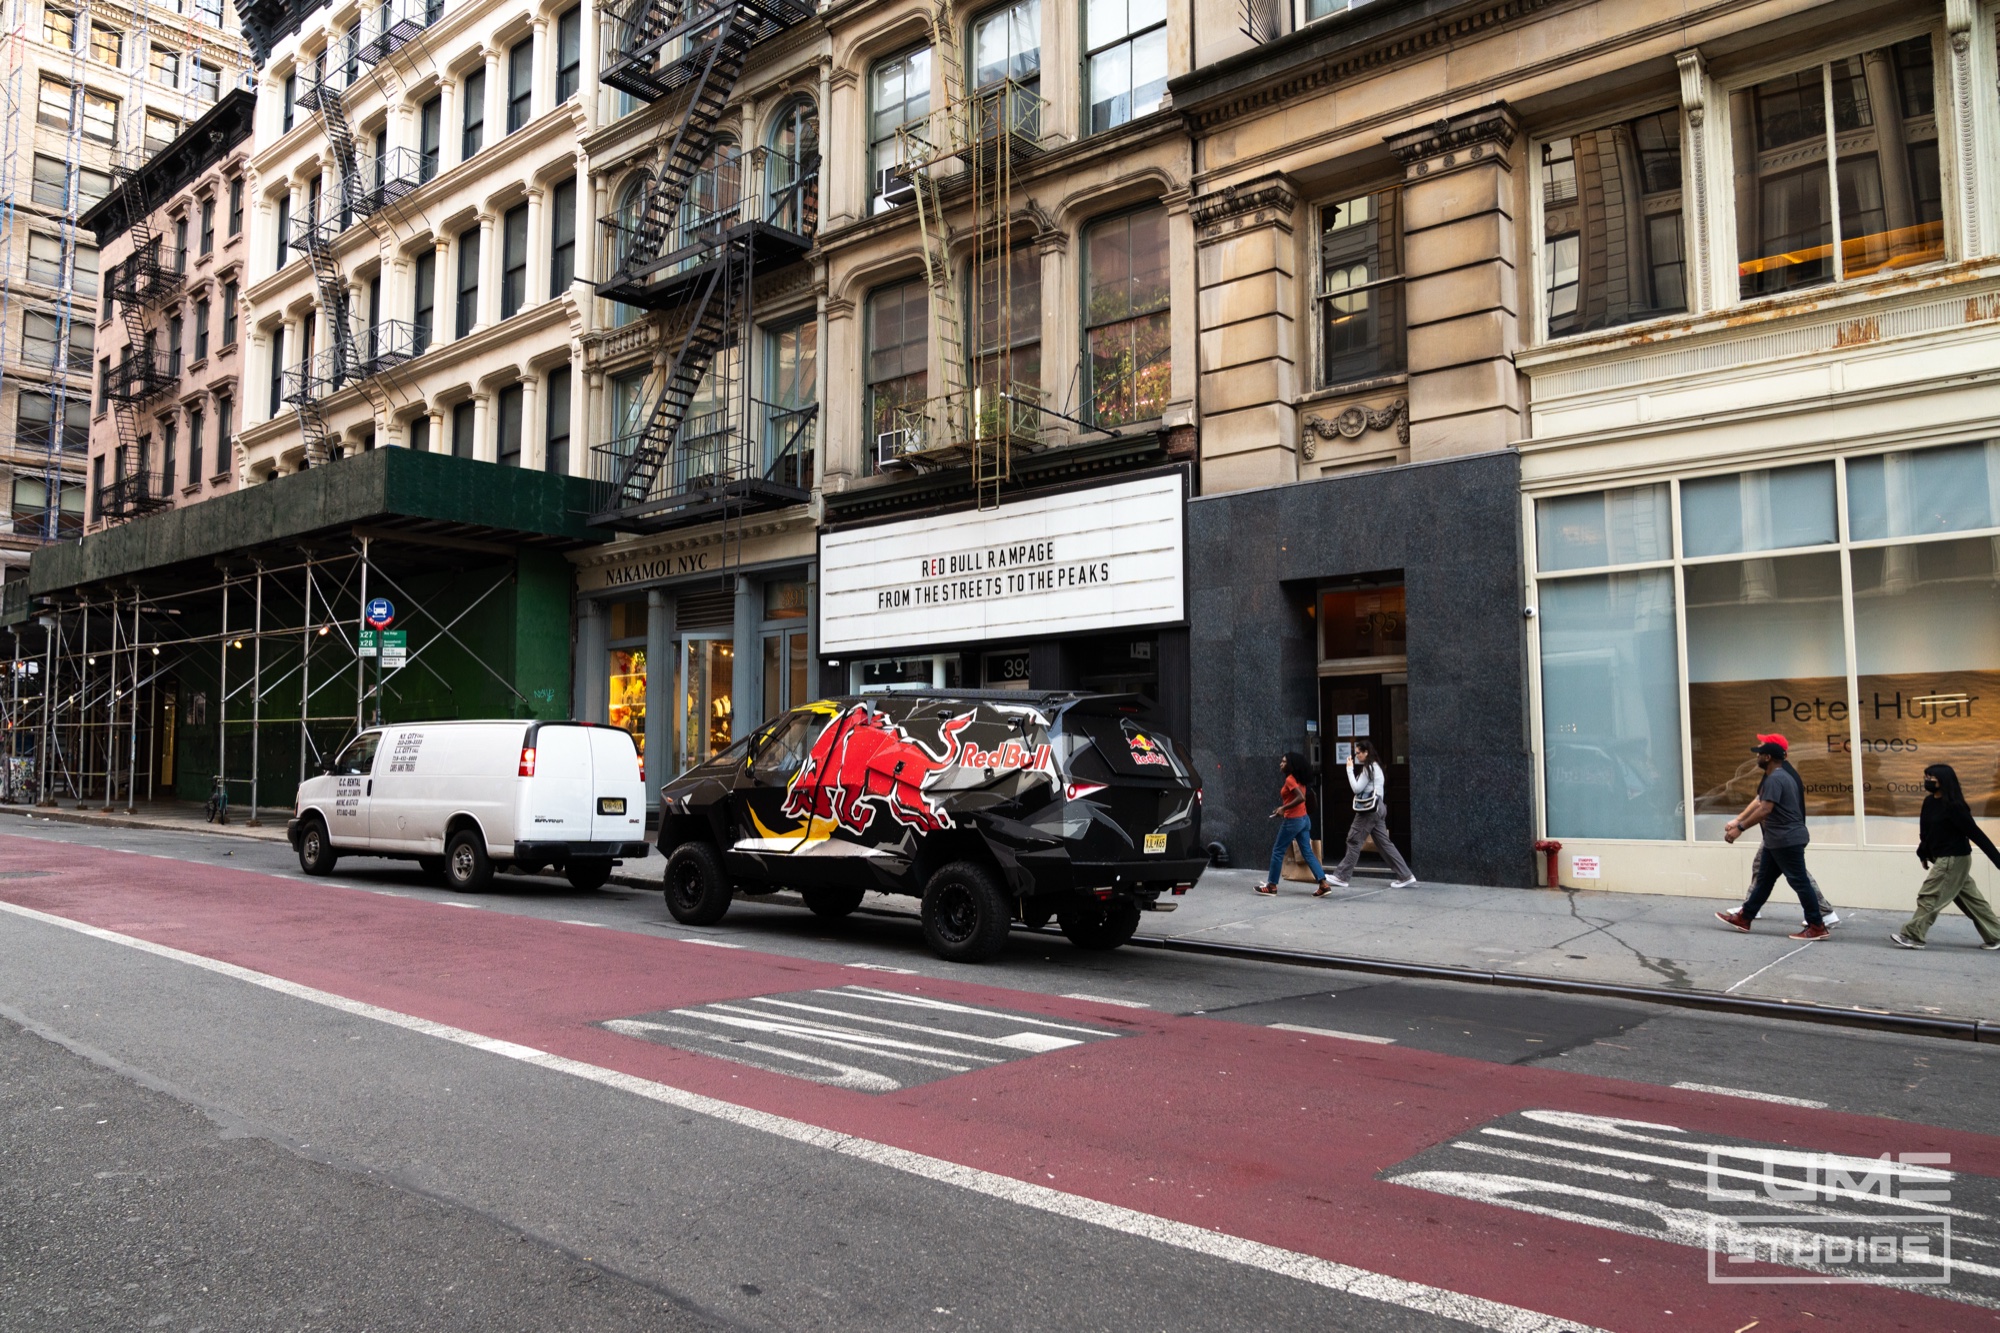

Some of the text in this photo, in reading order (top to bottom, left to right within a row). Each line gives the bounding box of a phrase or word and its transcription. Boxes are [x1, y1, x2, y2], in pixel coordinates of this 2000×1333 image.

[606, 552, 708, 586] NAKAMOL NYC
[922, 541, 1054, 578] RED BULL RAMPAGE
[878, 588, 911, 609] FROM
[1058, 562, 1110, 587] PEAKS
[1874, 690, 1979, 725] Hujar
